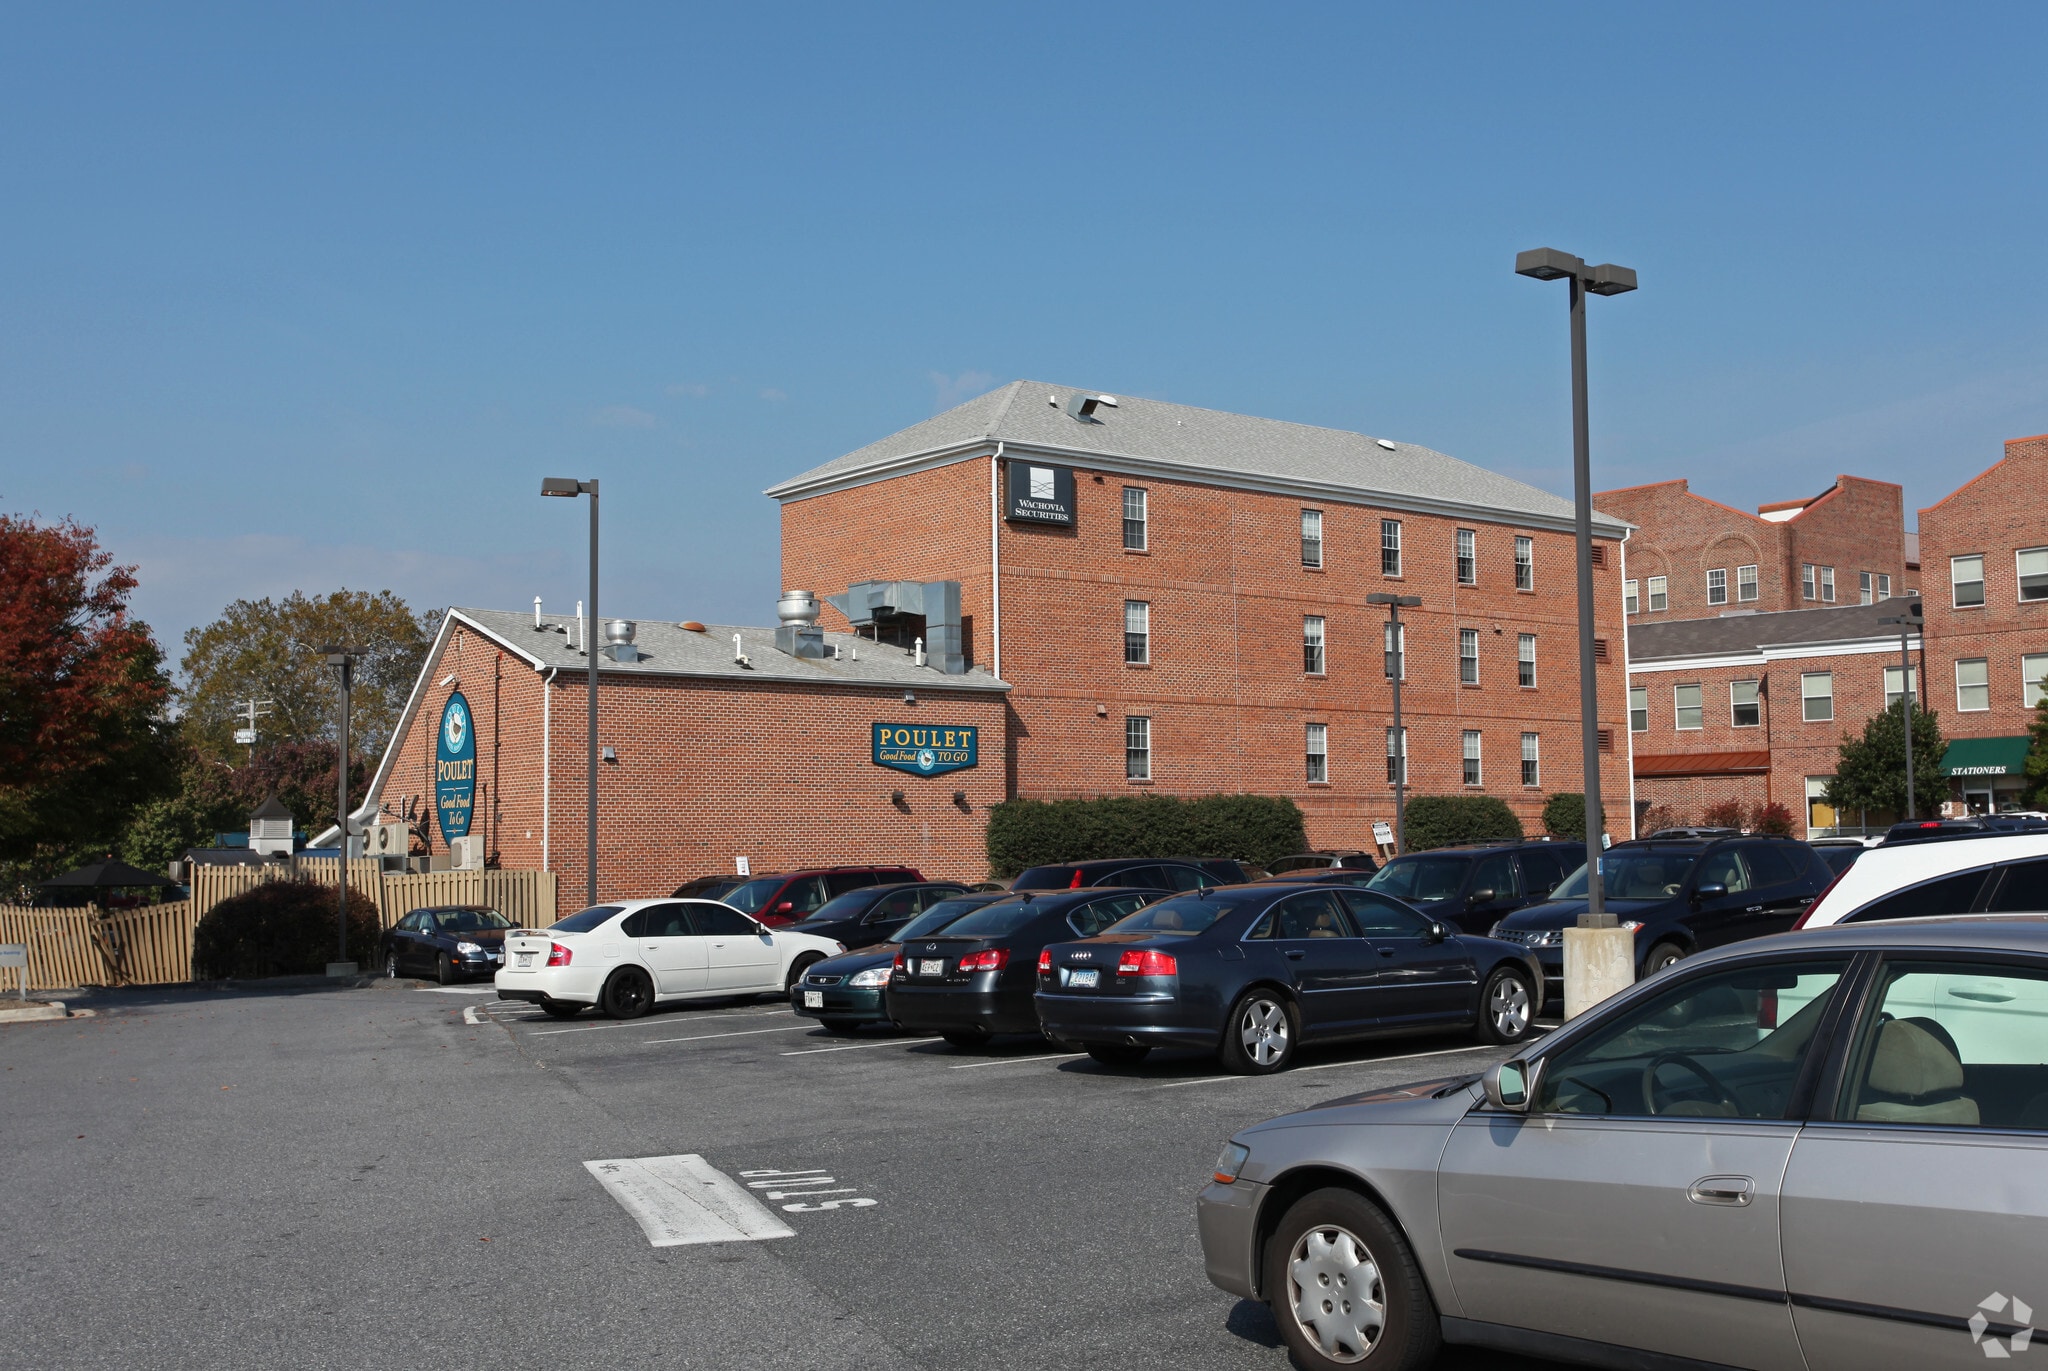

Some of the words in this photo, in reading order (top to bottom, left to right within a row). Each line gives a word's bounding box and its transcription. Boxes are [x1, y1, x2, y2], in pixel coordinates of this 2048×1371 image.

[1018, 499, 1065, 512] WACHOVIA
[1015, 508, 1069, 521] SECURITIES
[880, 729, 971, 748] POULET
[880, 750, 899, 760] Good
[899, 751, 917, 761] Food
[938, 751, 951, 761] TO
[953, 752, 968, 762] GO
[437, 759, 474, 781] POULET
[1951, 766, 2007, 775] STATIONERS
[440, 794, 456, 809] Good
[456, 793, 471, 808] Food
[449, 811, 455, 825] To
[456, 811, 464, 825] Go
[739, 1169, 878, 1213] STOP
